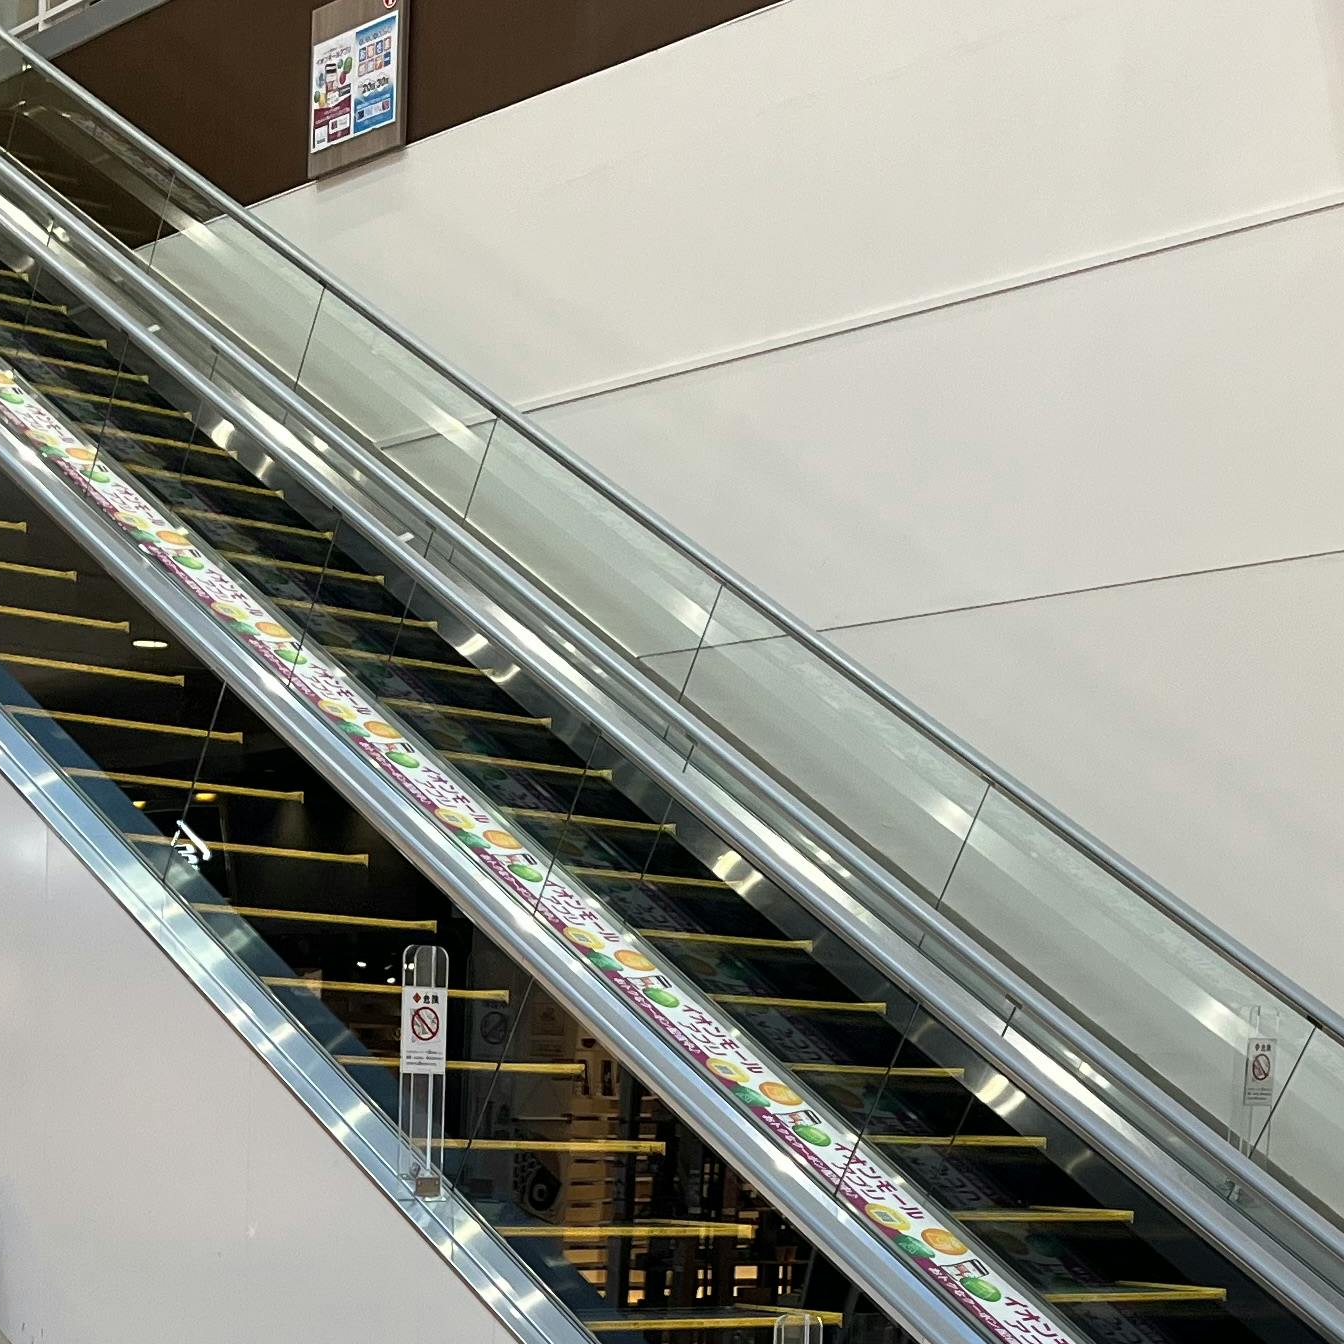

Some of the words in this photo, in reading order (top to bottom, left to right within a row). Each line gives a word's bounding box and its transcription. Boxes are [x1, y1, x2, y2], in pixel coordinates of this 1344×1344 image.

[682, 1003, 765, 1074] イオンモール
[834, 1141, 926, 1221] イオンモール
